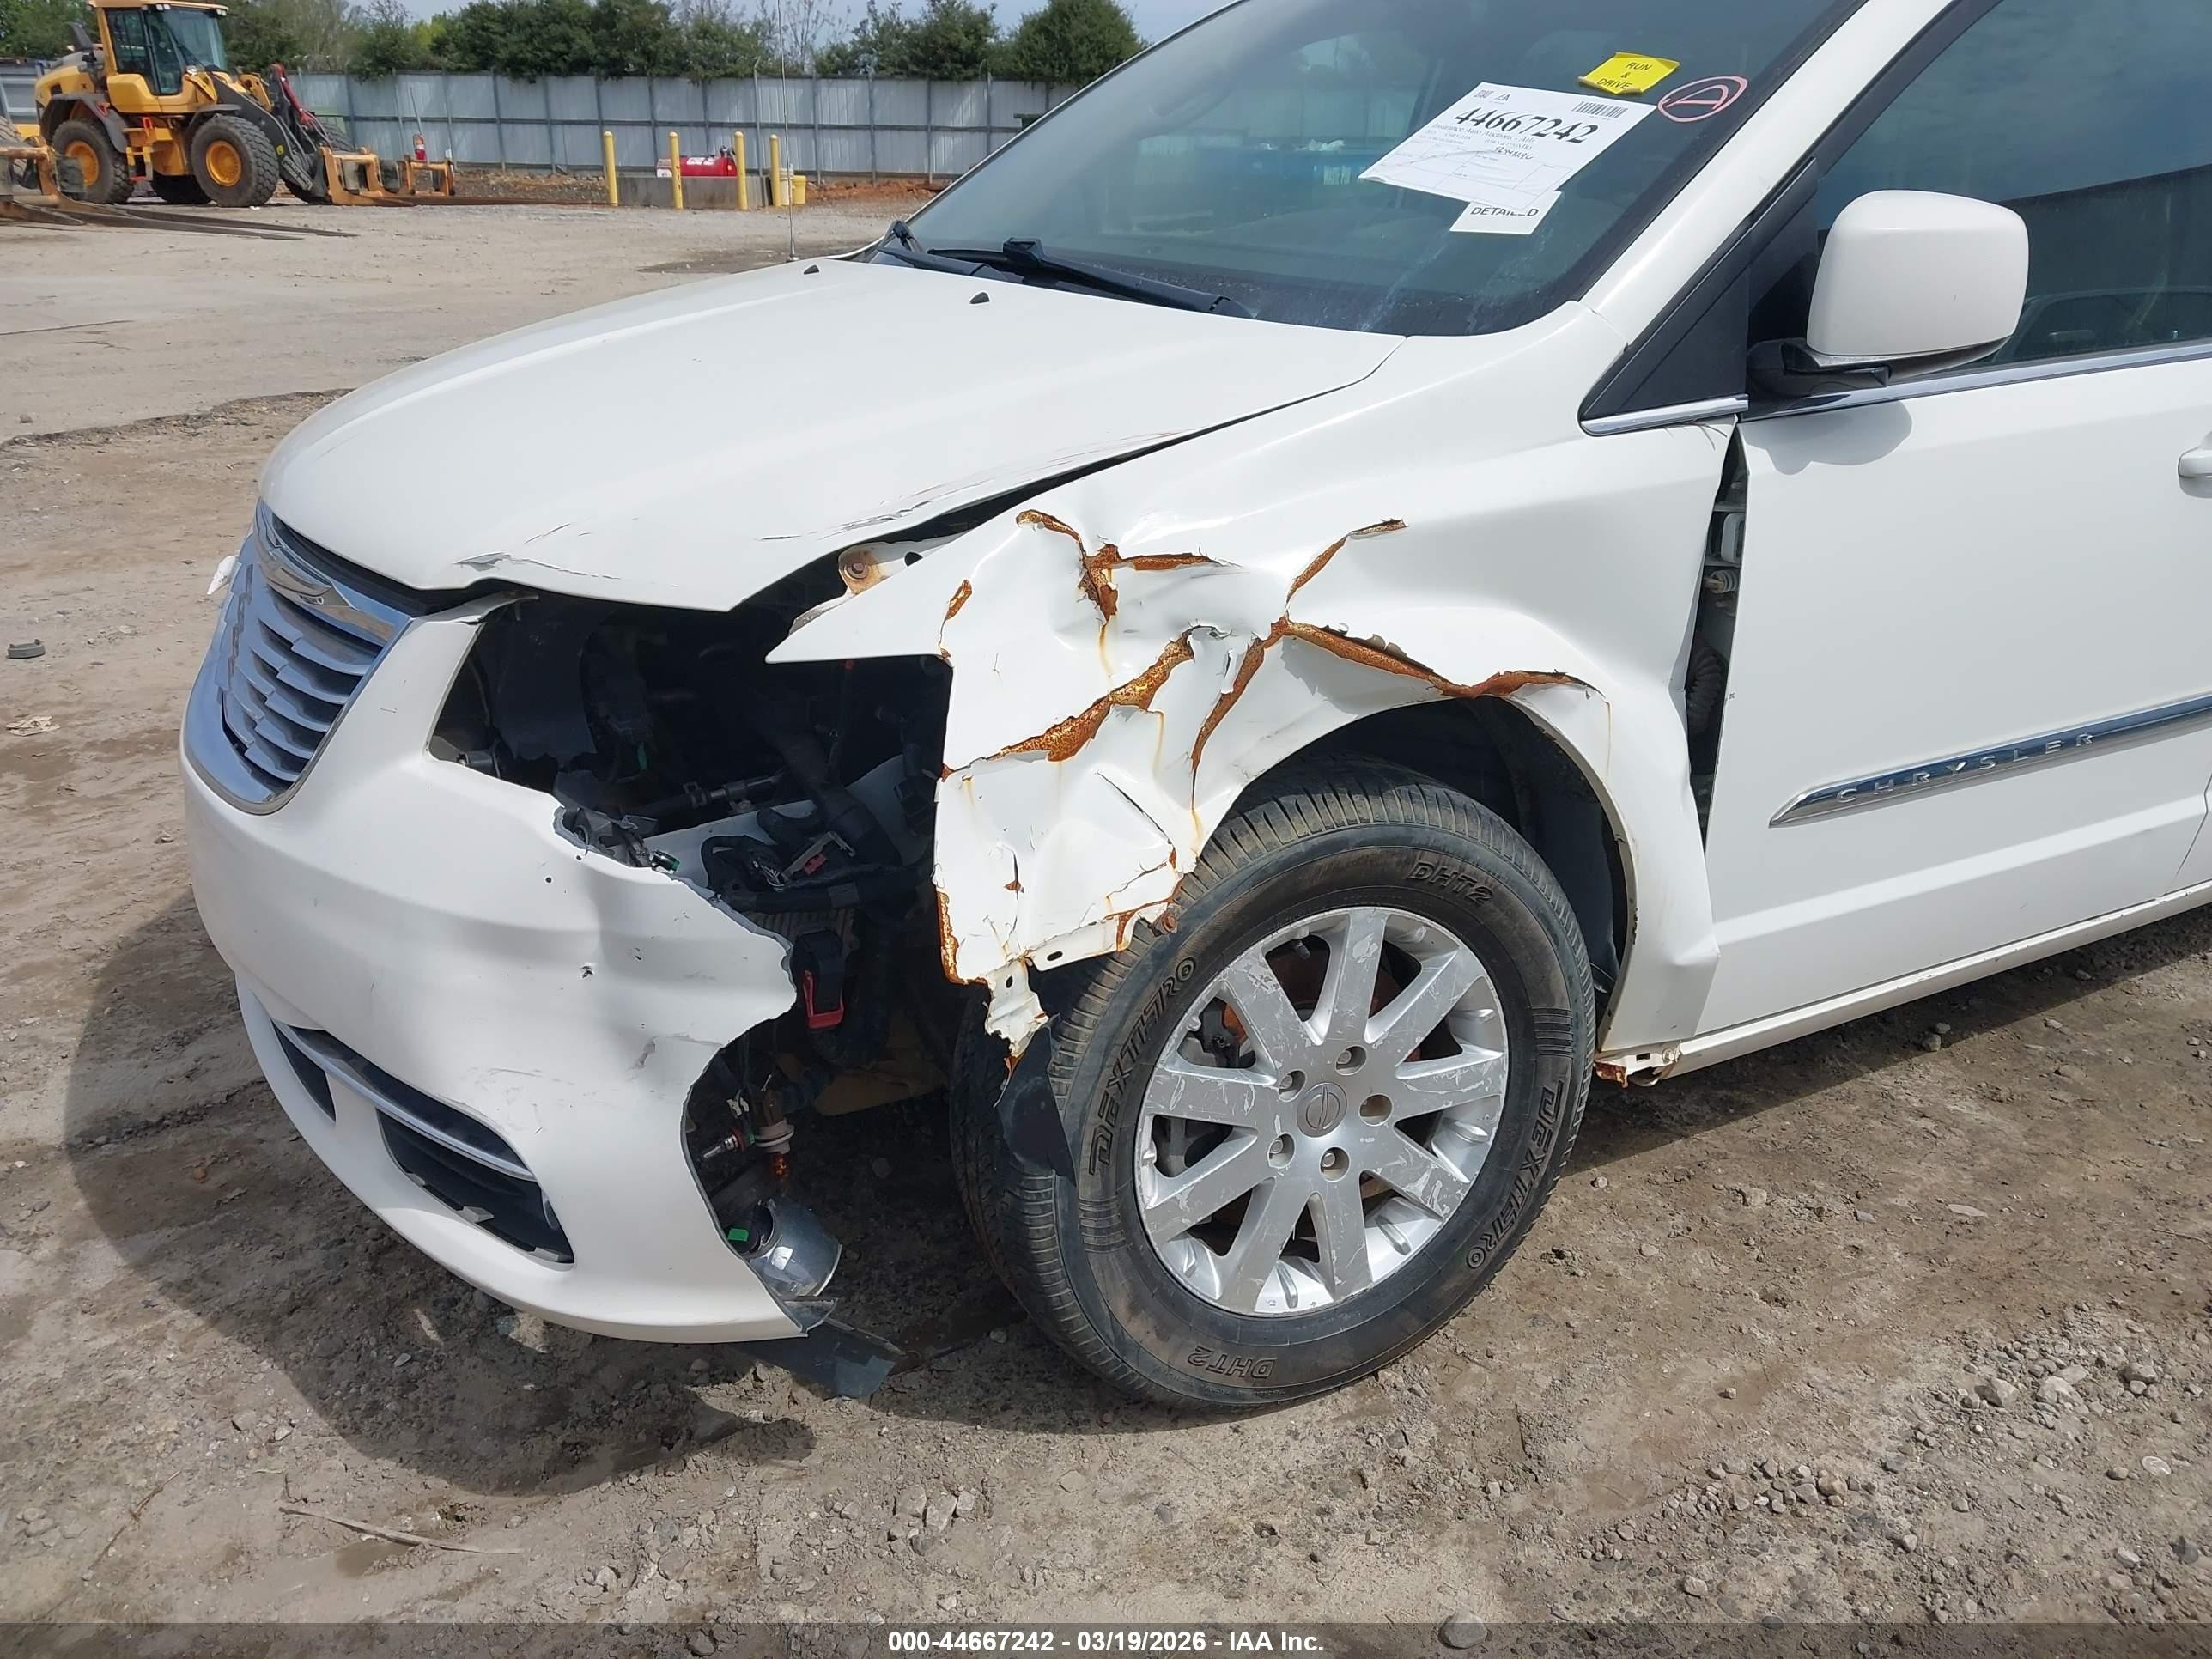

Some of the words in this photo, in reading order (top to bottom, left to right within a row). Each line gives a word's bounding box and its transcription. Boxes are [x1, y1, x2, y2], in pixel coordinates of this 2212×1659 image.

[1597, 78, 1632, 90] DRIVE
[1626, 62, 1653, 71] RUN
[1454, 106, 1599, 144] 44667242
[1836, 732, 2095, 804] CHRYSLER
[1408, 860, 1493, 908] DHT2
[1088, 957, 1196, 1176] DEXTERO
[1466, 1079, 1564, 1269] DEXTERO
[1187, 1345, 1278, 1379] DHT2
